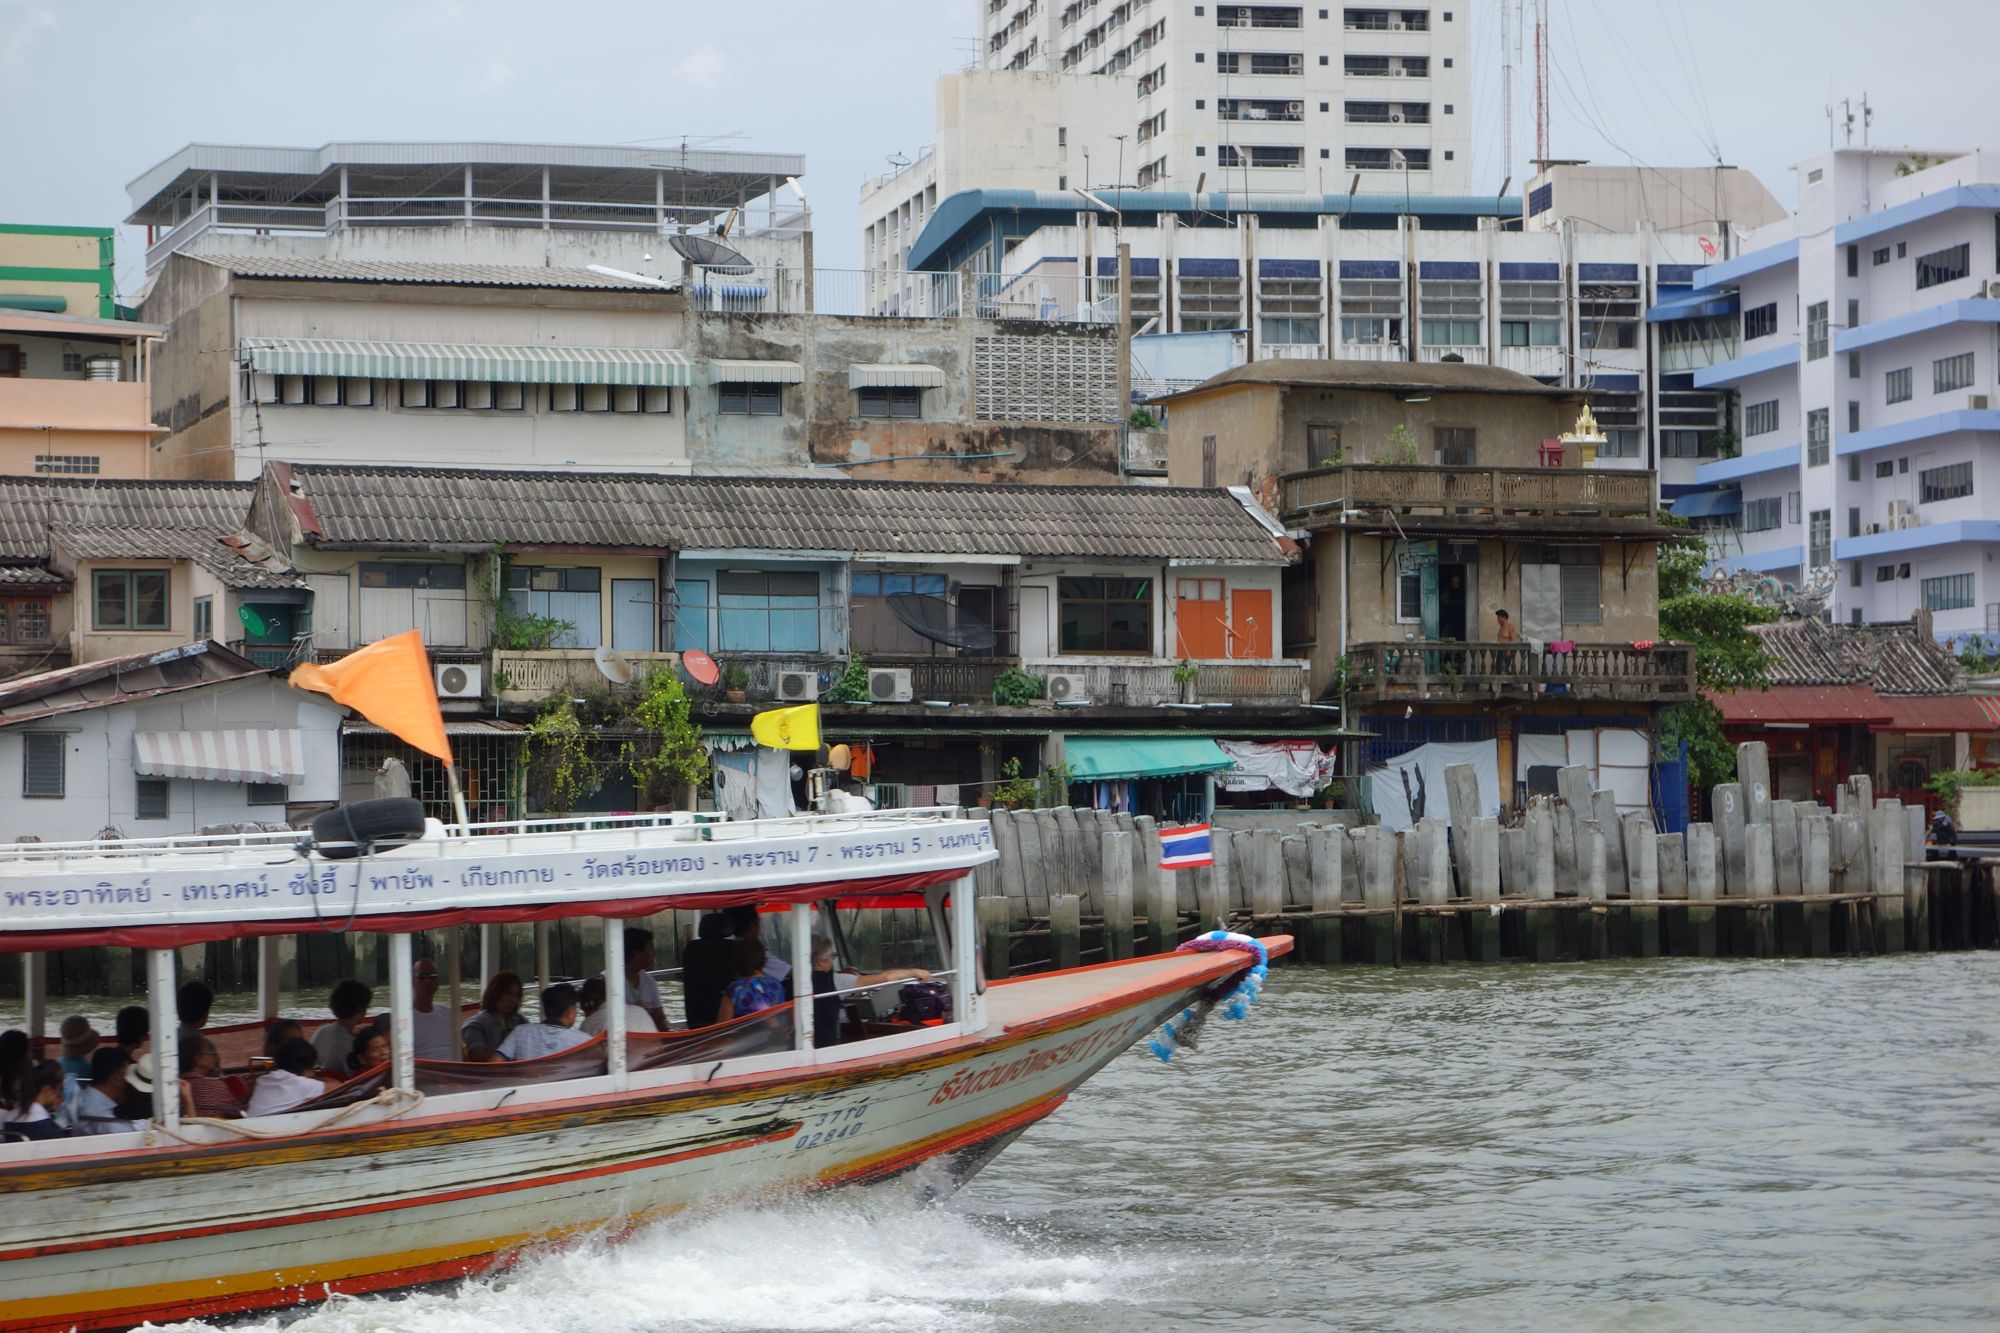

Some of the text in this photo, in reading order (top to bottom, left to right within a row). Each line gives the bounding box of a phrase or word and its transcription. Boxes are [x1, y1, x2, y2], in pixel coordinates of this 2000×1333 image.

[1724, 791, 1735, 812] 9
[1754, 782, 1765, 803] 8
[4, 878, 151, 906] พระอาทิตย์
[369, 867, 434, 891] พายัพ
[460, 864, 554, 888] เกียกกาย
[581, 854, 706, 879] วัดสร้อยทอง
[727, 849, 800, 868] พระราม
[807, 846, 819, 863] 7
[840, 840, 906, 860] พระราม
[911, 836, 922, 854] 5
[938, 825, 991, 851] นนทบุรี
[795, 1122, 863, 1149] 02840
